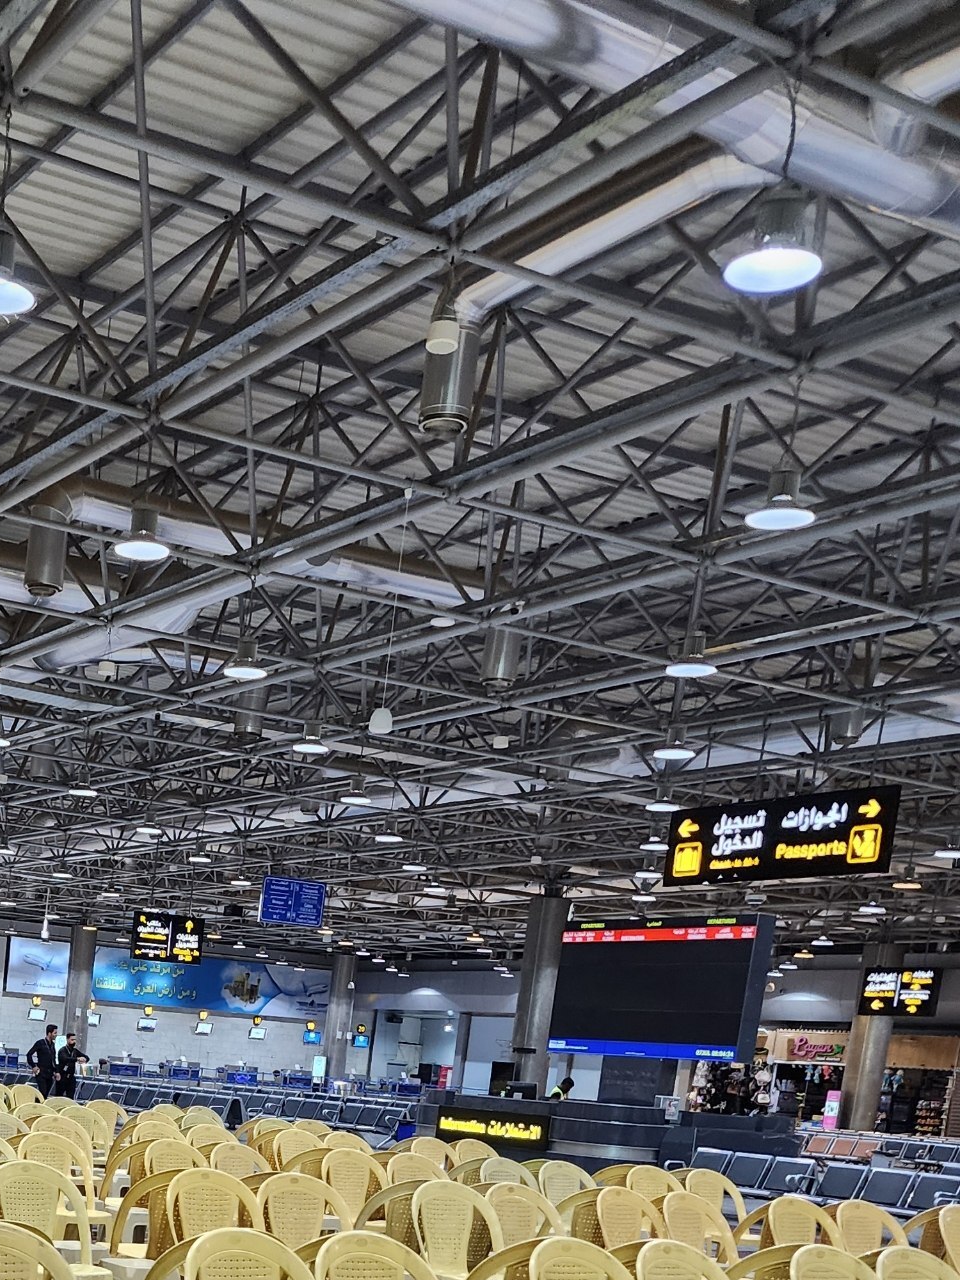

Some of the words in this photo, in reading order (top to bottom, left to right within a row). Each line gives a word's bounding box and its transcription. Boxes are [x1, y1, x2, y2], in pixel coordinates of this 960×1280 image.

[712, 809, 767, 836] تسجيل
[781, 802, 849, 831] الجوازات
[711, 830, 764, 856] الدخول
[775, 839, 847, 860] Passports
[439, 1116, 486, 1133] Information
[487, 1120, 542, 1140] الاستعلامات
